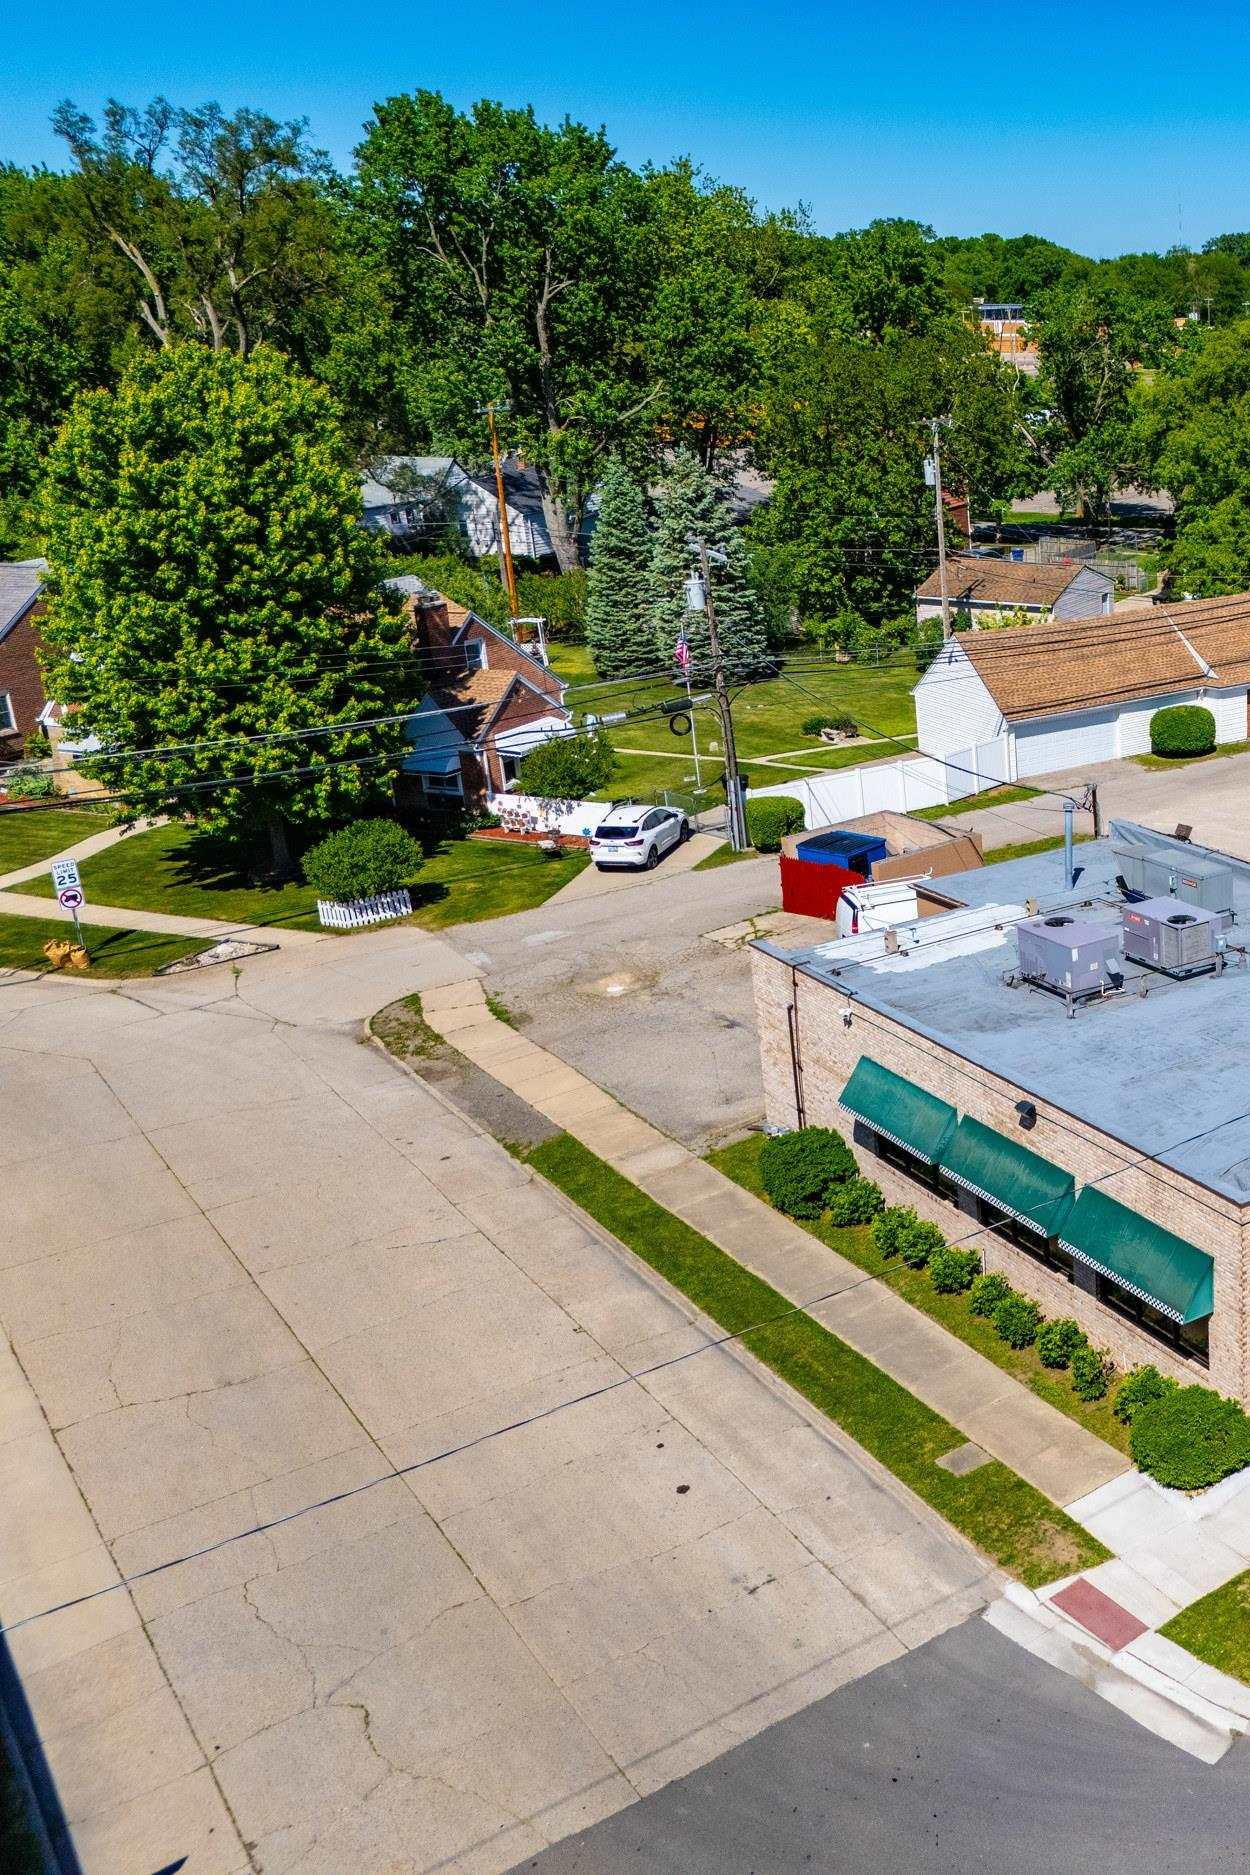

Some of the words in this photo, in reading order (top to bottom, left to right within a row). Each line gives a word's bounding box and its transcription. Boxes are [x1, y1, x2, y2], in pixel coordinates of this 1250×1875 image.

[53, 862, 75, 870] SPEED
[56, 867, 74, 875] LIMIT
[57, 873, 77, 886] 25
